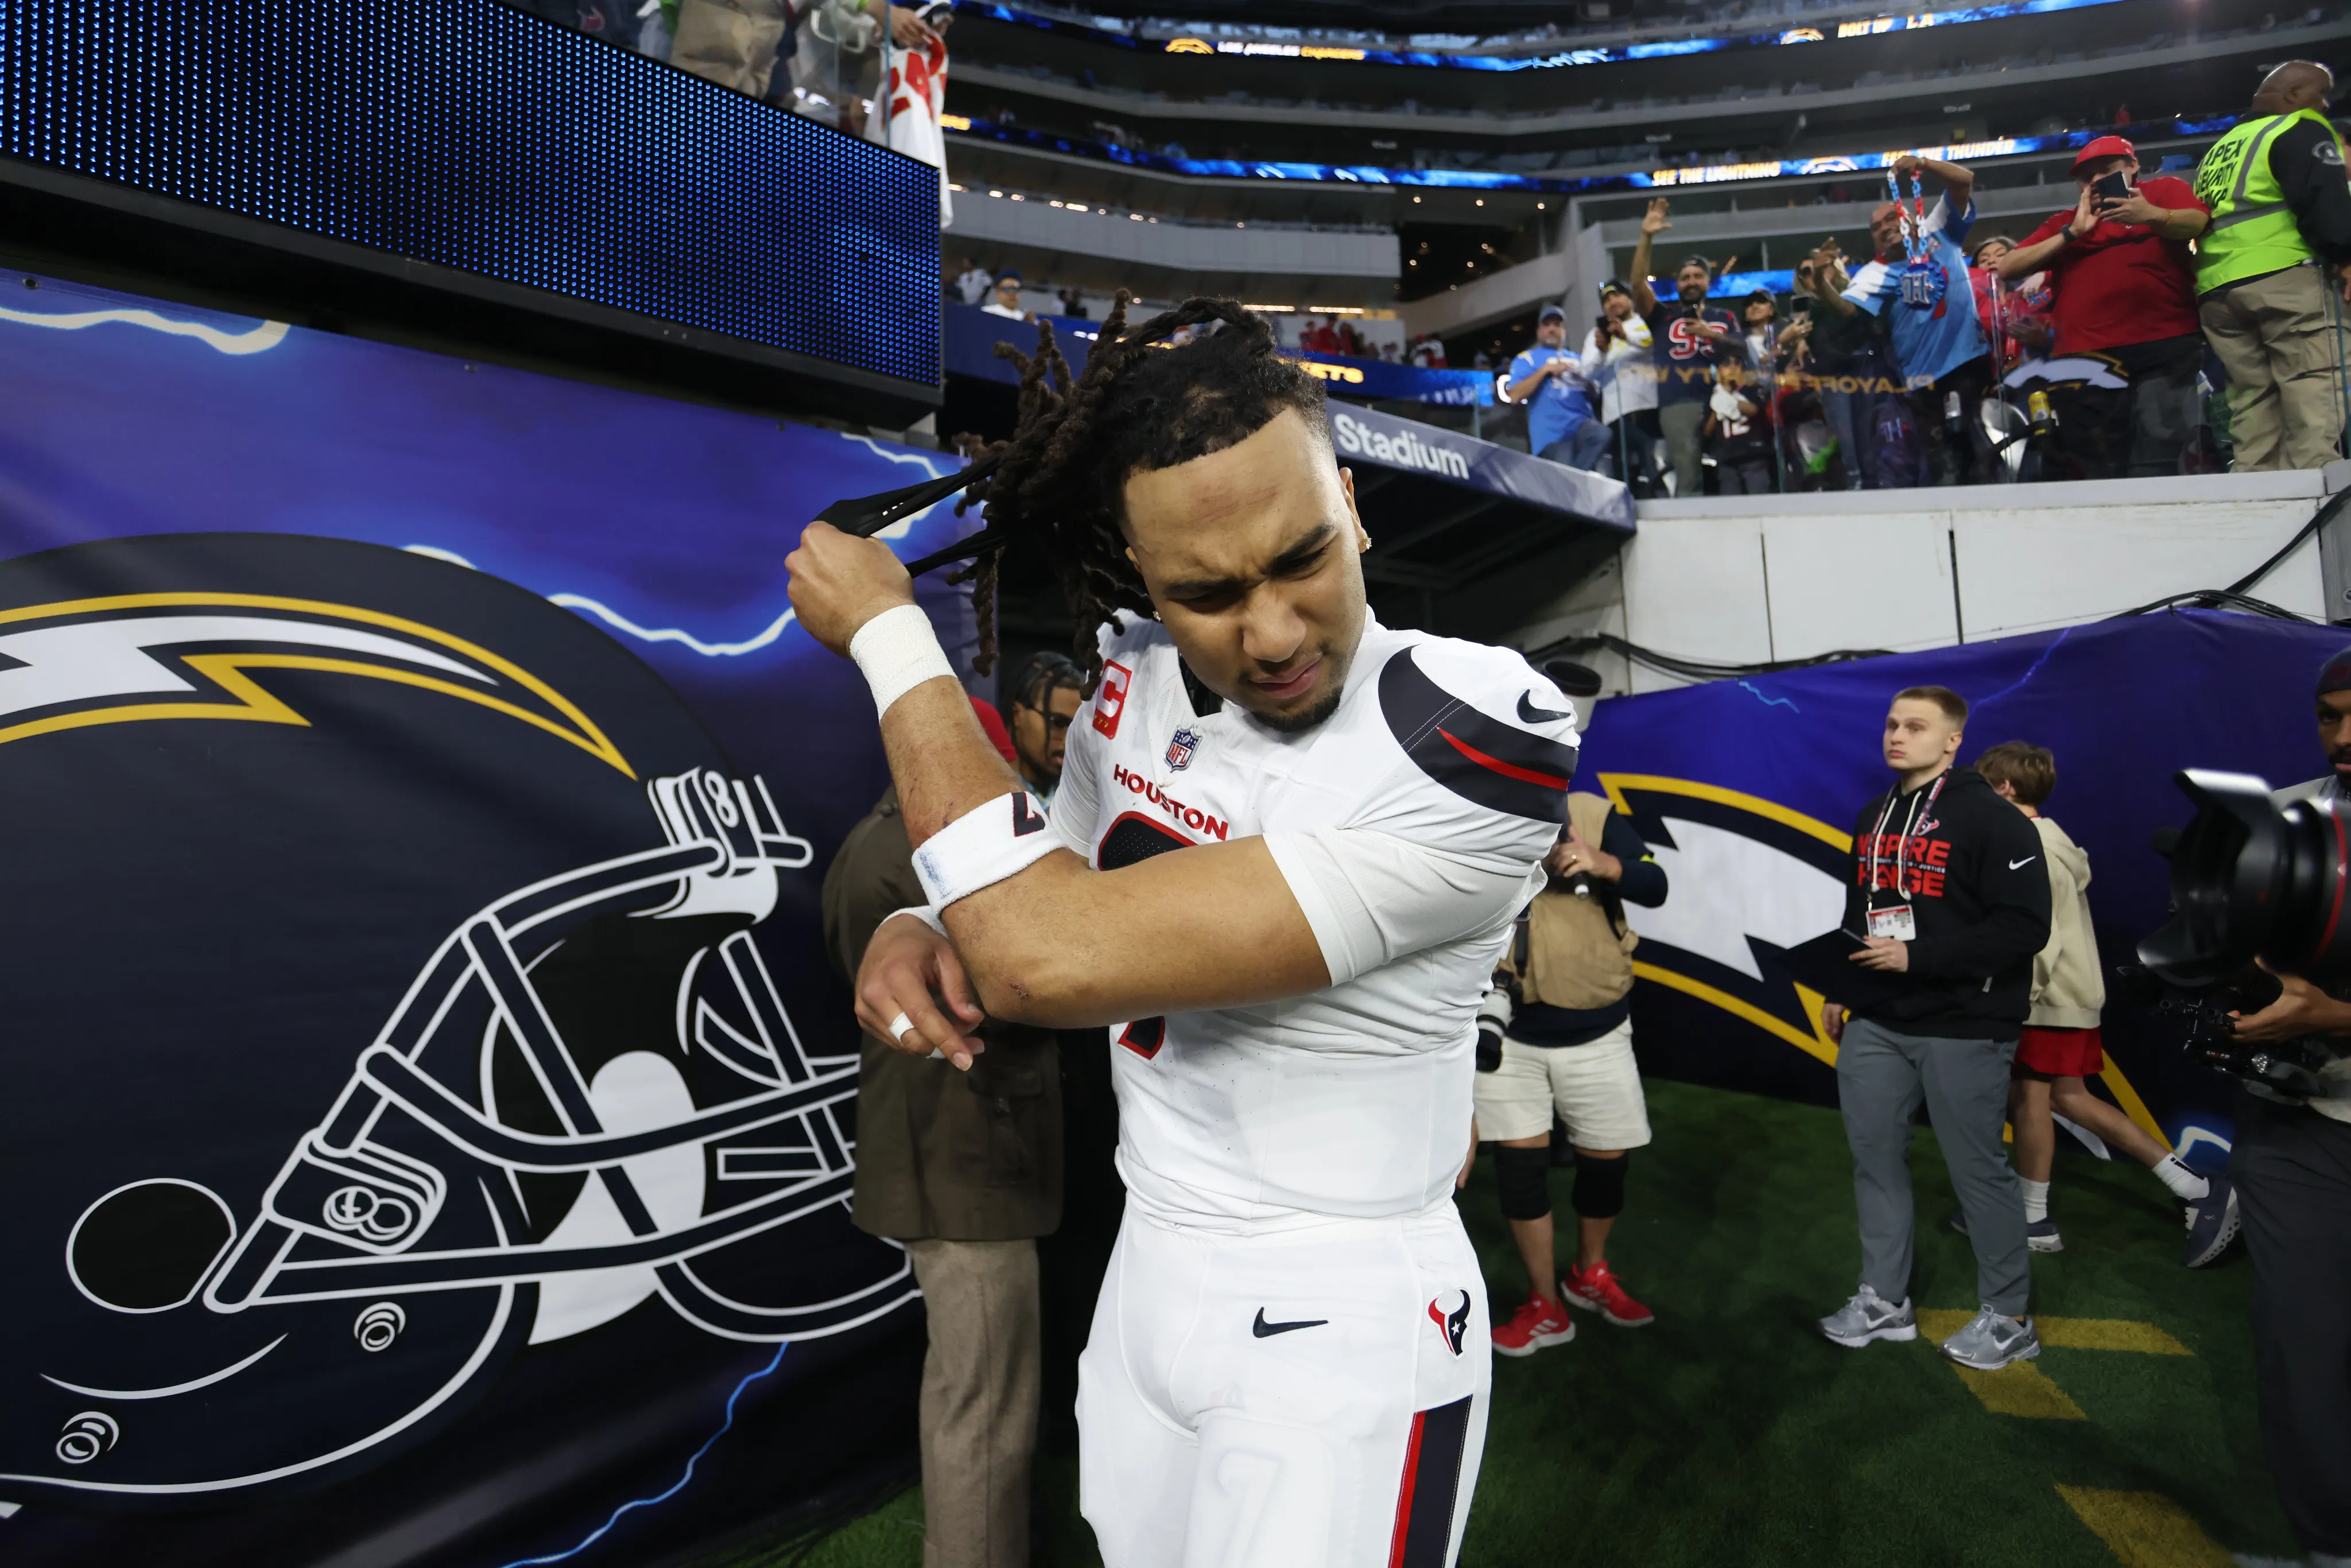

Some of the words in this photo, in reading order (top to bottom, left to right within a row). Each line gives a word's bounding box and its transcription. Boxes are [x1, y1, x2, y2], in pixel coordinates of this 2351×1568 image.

[1906, 13, 1934, 29] LA
[1946, 138, 2016, 161] THUNDER
[1334, 413, 1469, 480] Stadium
[1096, 665, 1127, 717] C
[1167, 743, 1189, 764] NFL
[1114, 763, 1228, 841] HOUSTON
[1857, 833, 1951, 868] NSPIRE
[1857, 862, 1945, 898] HANGE
[1918, 863, 1946, 874] JUSTICE
